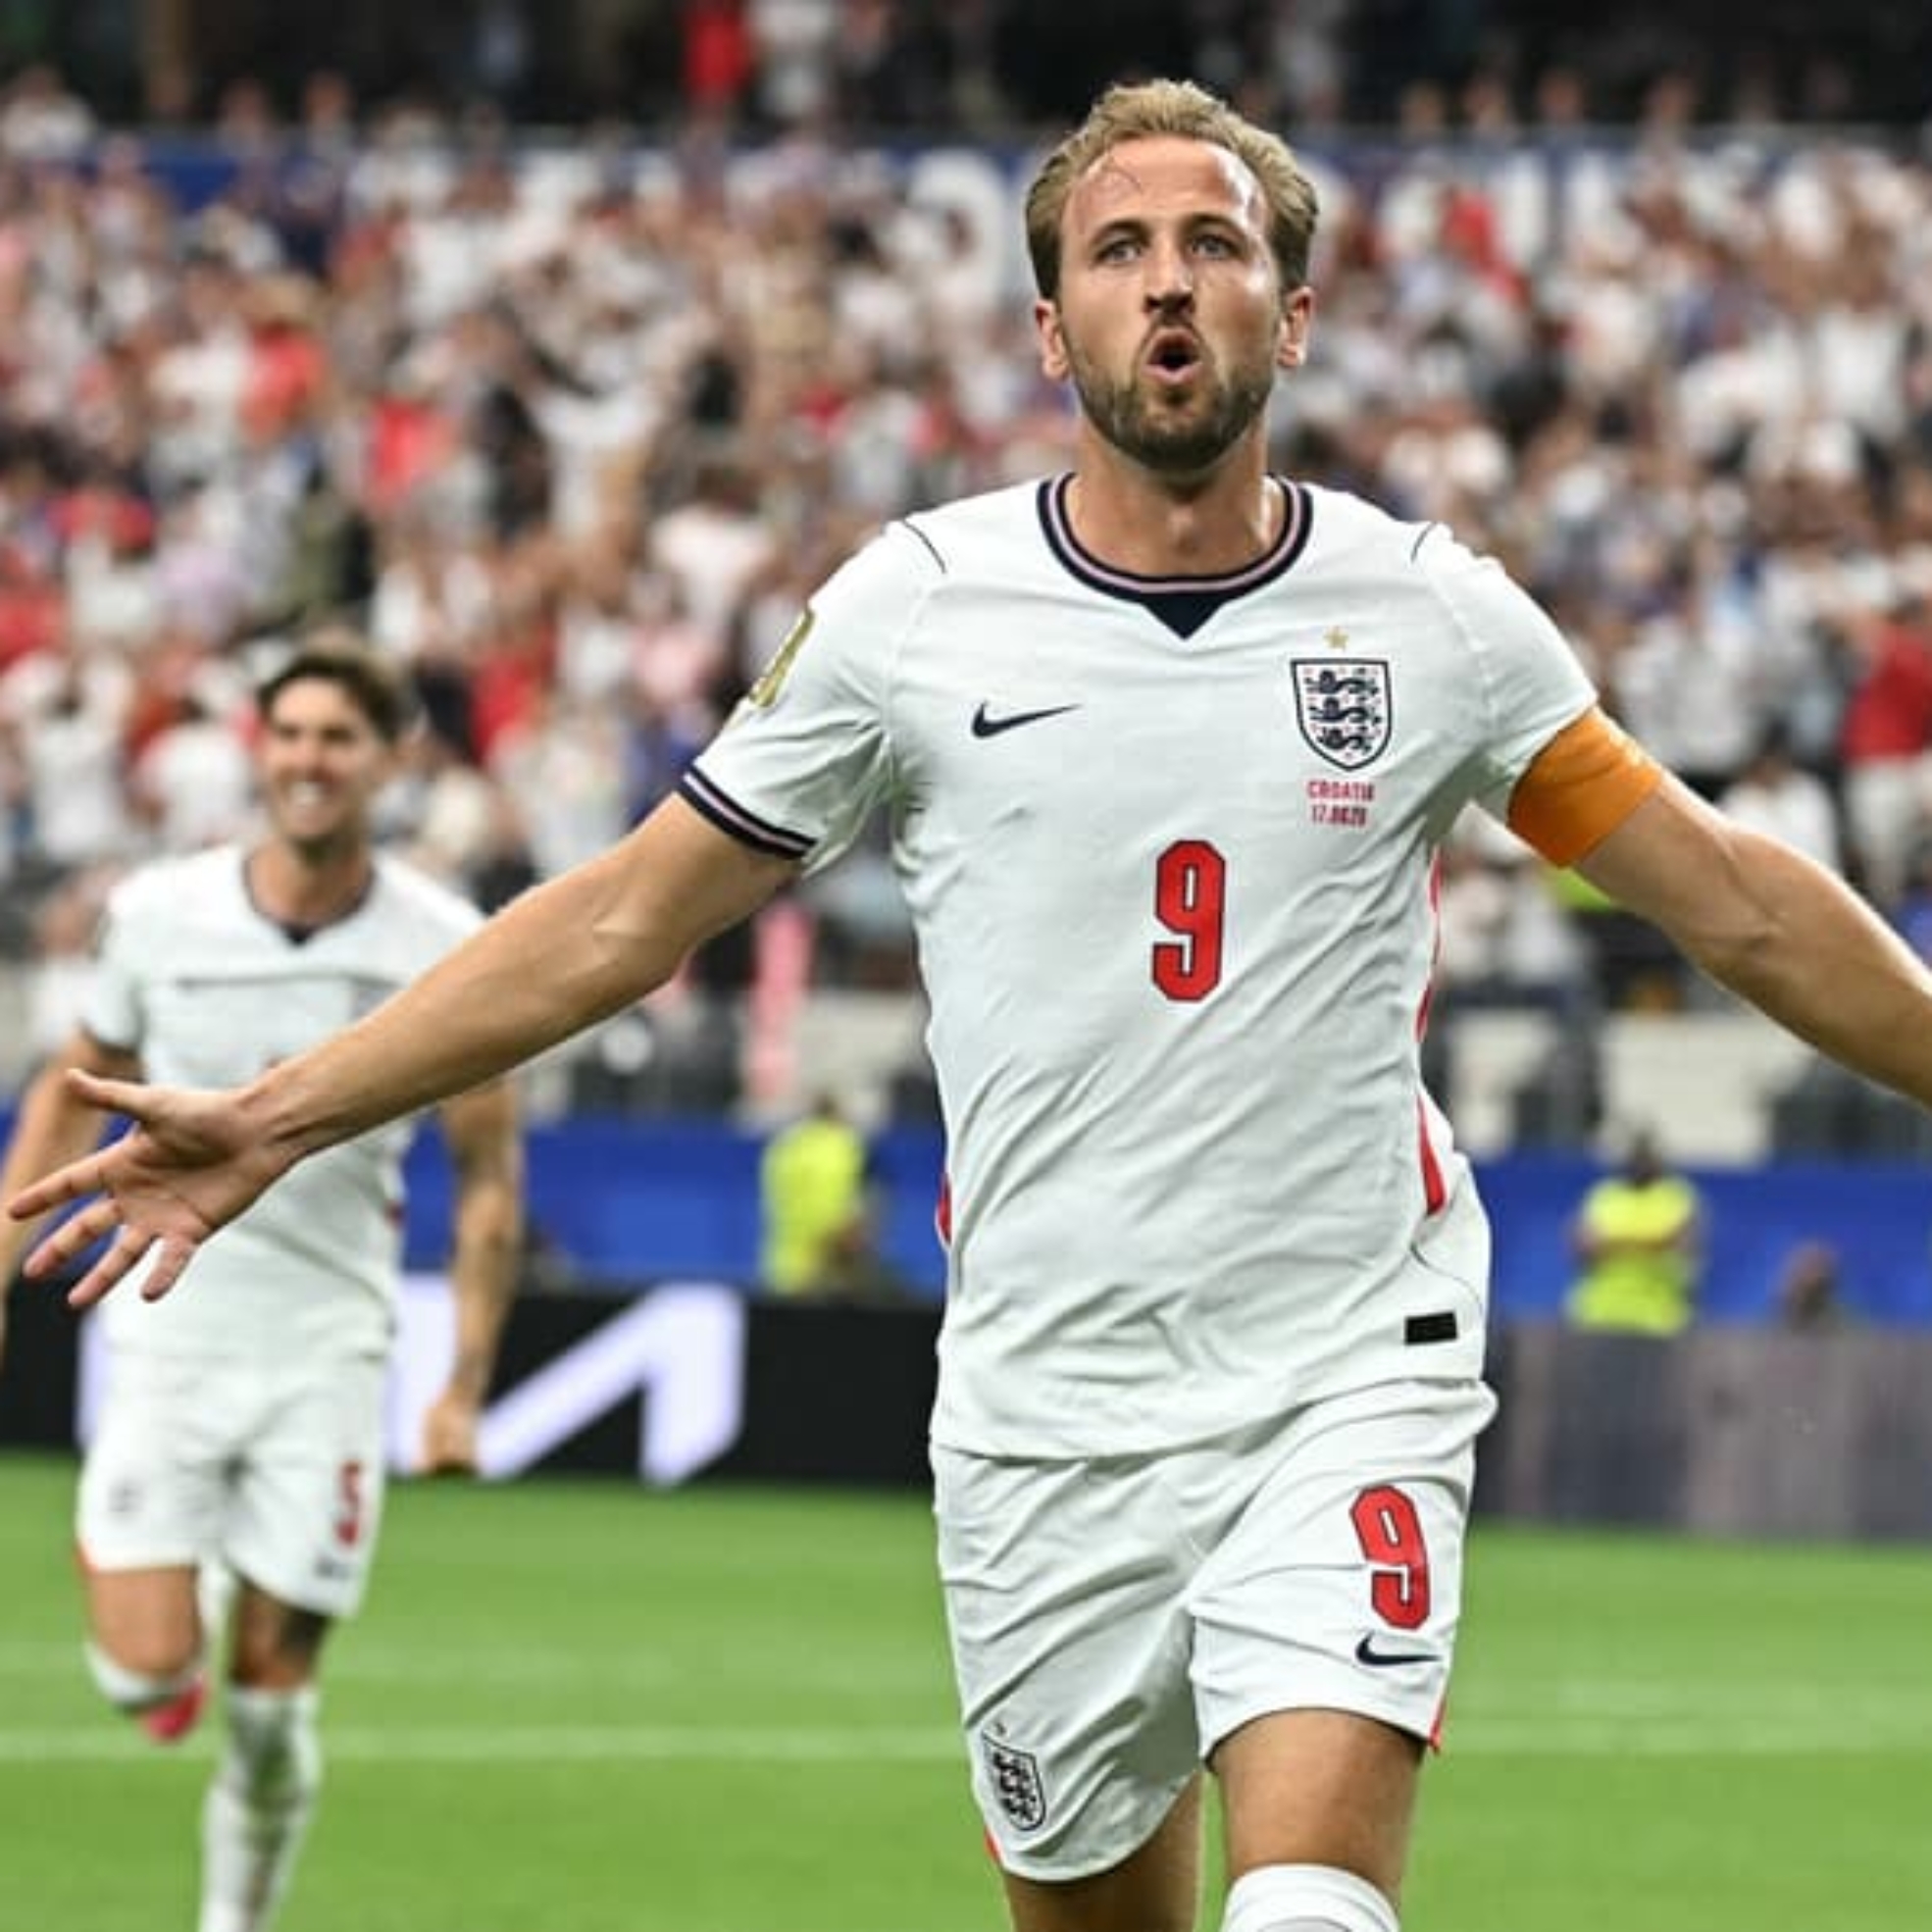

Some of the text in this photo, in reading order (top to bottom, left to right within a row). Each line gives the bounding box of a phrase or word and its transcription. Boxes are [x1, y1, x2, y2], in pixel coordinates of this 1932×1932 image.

[1307, 781, 1375, 800] CROATIA
[1150, 839, 1226, 1002] 9
[1348, 1484, 1431, 1632] 9
